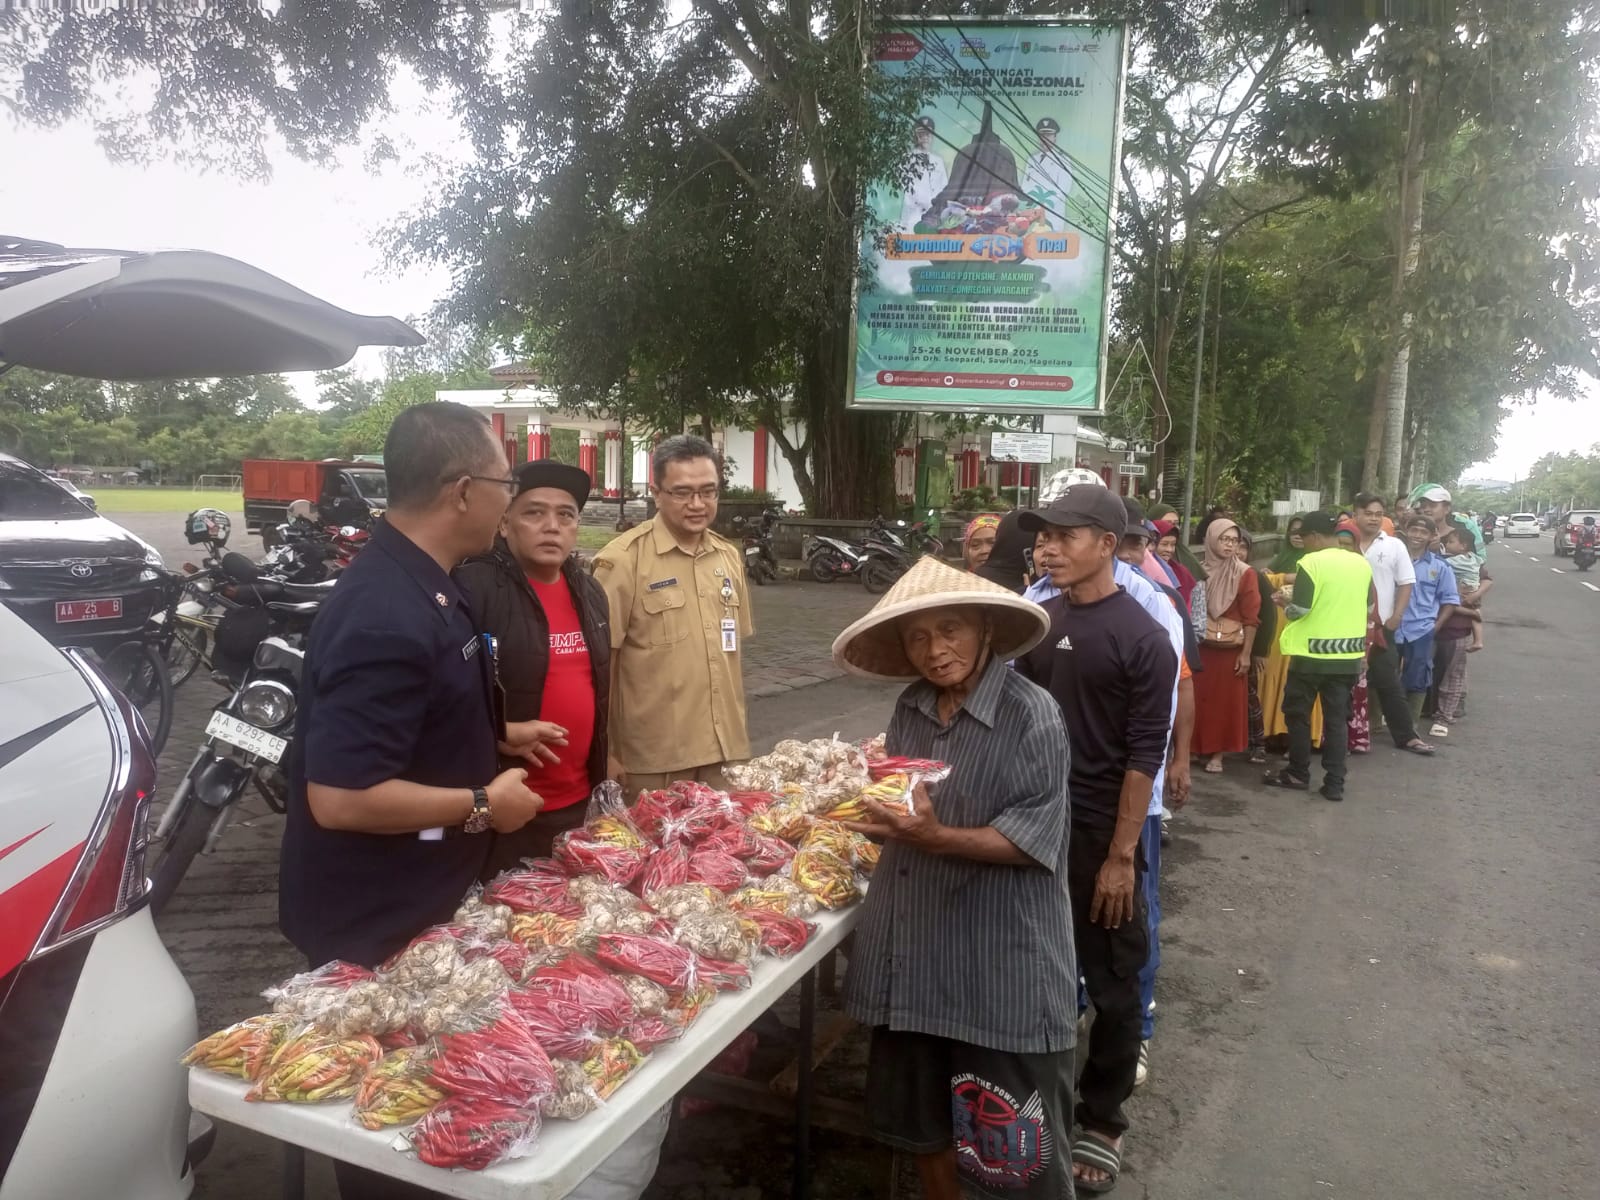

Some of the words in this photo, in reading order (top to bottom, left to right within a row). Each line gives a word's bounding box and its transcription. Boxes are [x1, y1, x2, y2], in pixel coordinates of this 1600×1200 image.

[950, 68, 1034, 78] MEMPERINGATI
[1003, 77, 1085, 88] NASIONAL
[992, 89, 1029, 97] Generasi
[1032, 89, 1055, 97] Emas
[1001, 272, 1034, 282] MAKMUR
[878, 303, 902, 312] LOMBA
[936, 304, 957, 313] VIDEO
[966, 305, 990, 314] LOMBA
[1053, 307, 1078, 315] LOMBA
[960, 314, 992, 323] FESTIVAL
[995, 315, 1018, 323] UMKM
[957, 323, 985, 331] KONTES
[988, 324, 1006, 332] IKAN
[1008, 324, 1032, 333] GUPPY
[1041, 326, 1081, 334] TALKSHOW
[974, 332, 992, 340] IKAN
[994, 333, 1011, 341] HIAS
[911, 346, 941, 354] 25-26
[945, 347, 1008, 356] NOVEMBER
[1012, 349, 1039, 357] 2025
[878, 354, 920, 362] Lapangan
[1029, 358, 1073, 367] Magelang
[61, 603, 73, 616] AA
[84, 602, 97, 614] 25
[113, 600, 119, 612] B
[213, 713, 230, 727] AA
[235, 722, 265, 743] 6292
[268, 737, 284, 752] CE
[993, 1085, 1021, 1110] POWER
